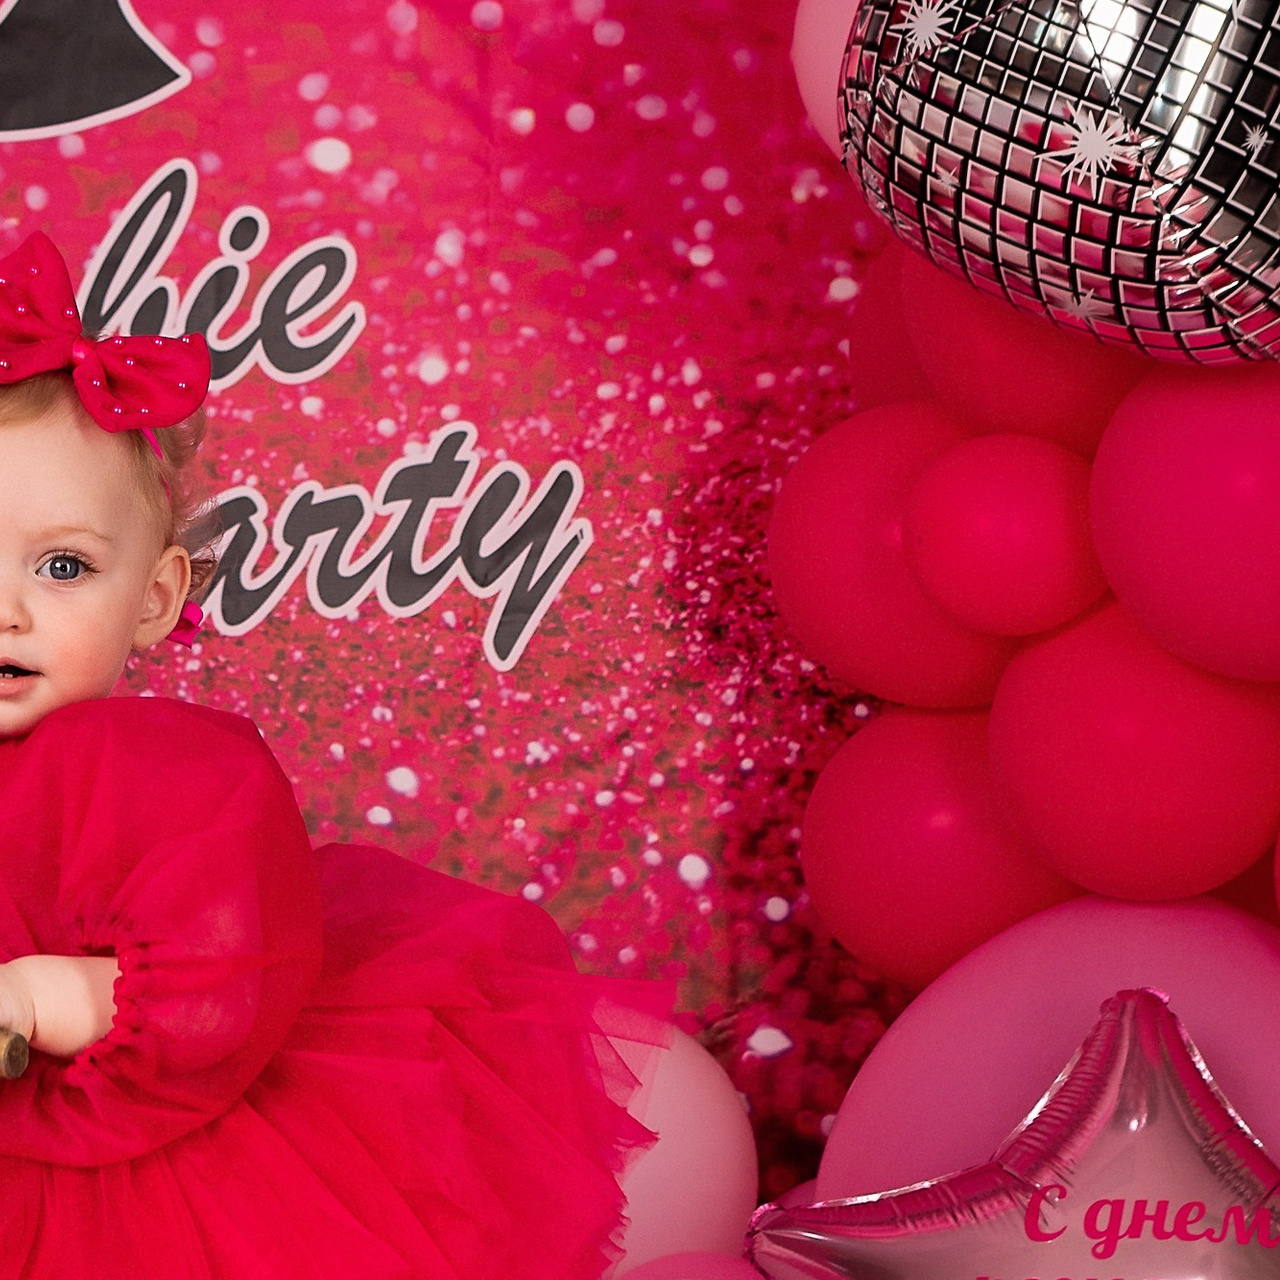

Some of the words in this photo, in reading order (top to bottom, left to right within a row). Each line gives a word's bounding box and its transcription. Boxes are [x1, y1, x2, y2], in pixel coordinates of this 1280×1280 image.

[194, 420, 595, 673] arty
[1023, 1184, 1069, 1243] С
[1083, 1195, 1280, 1261] днем
